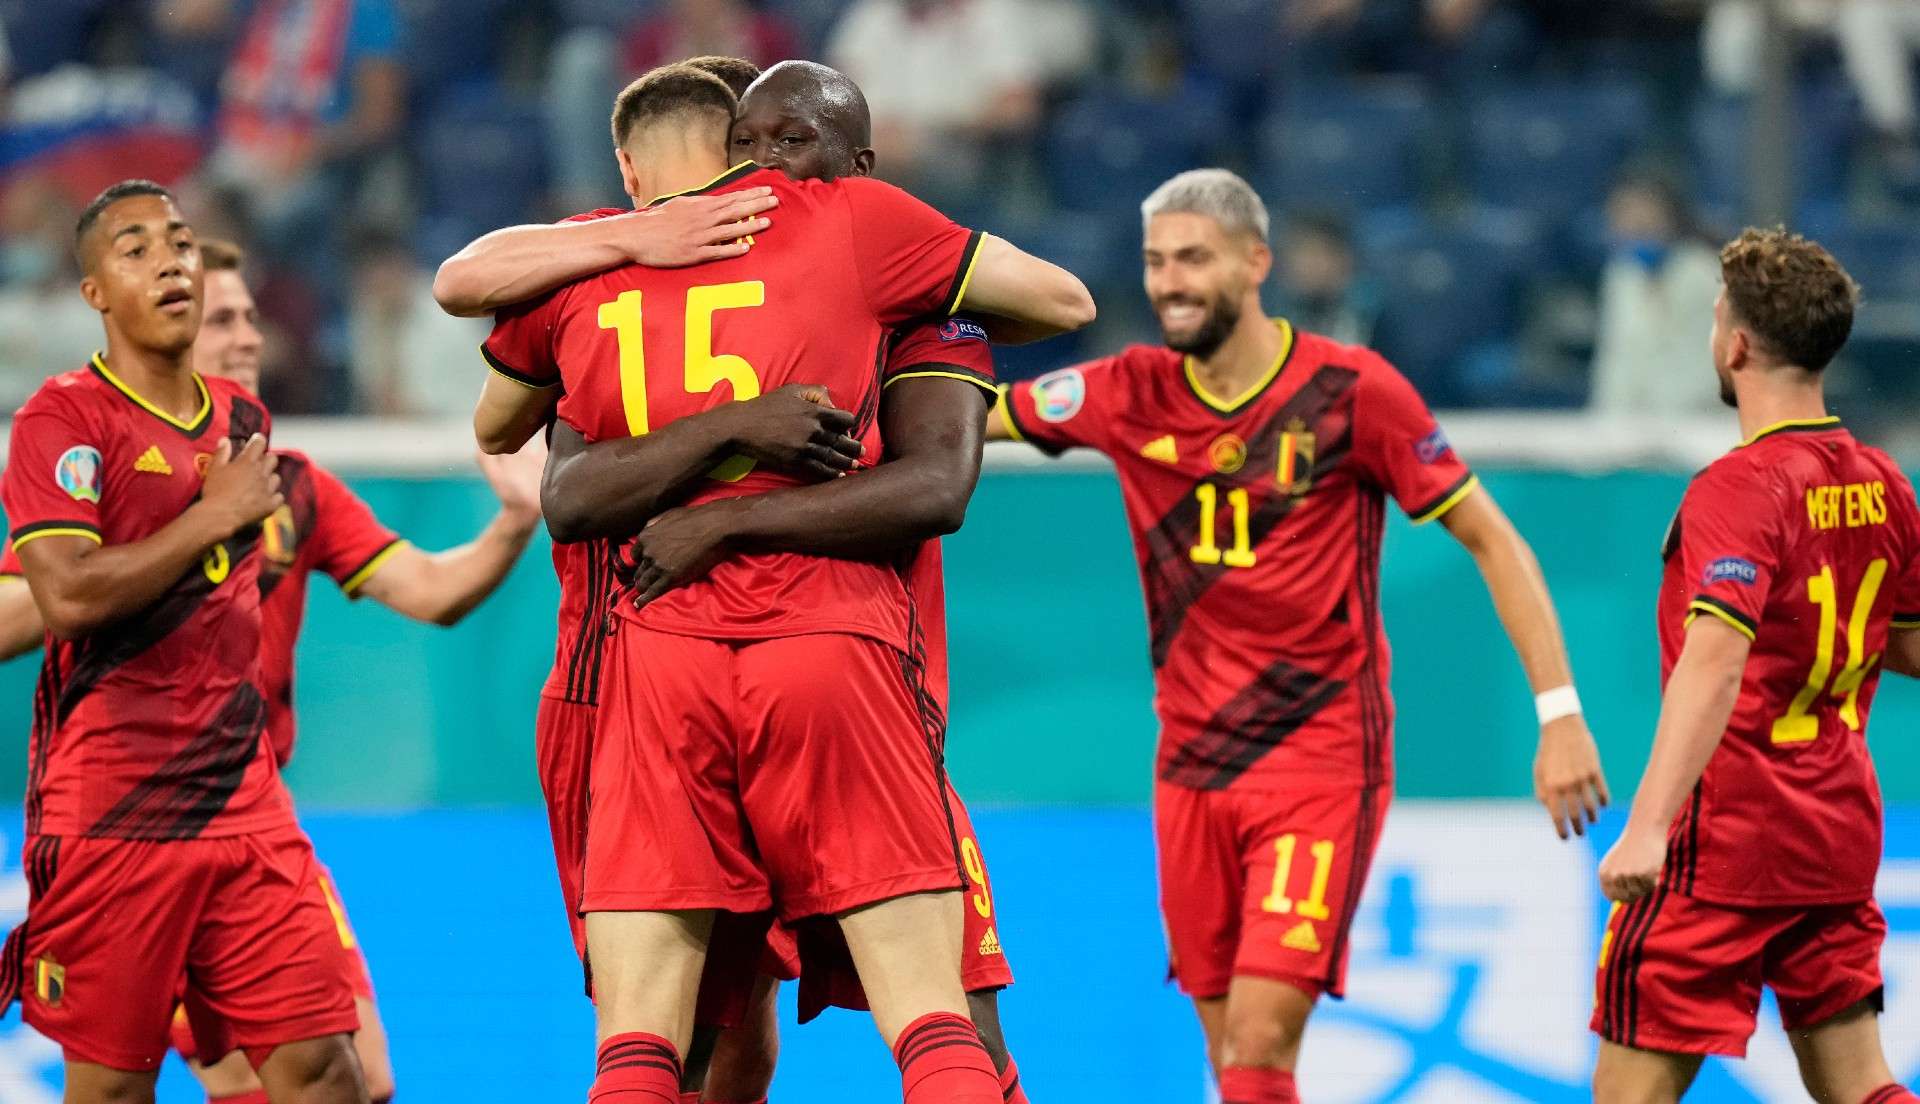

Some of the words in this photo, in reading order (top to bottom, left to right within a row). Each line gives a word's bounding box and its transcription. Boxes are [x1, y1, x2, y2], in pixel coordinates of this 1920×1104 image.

[597, 280, 765, 483] 15
[1189, 482, 1257, 568] 11
[1806, 480, 1887, 529] MERENS
[1770, 557, 1888, 744] 14
[961, 836, 991, 918] 9
[1261, 833, 1335, 921] 11
